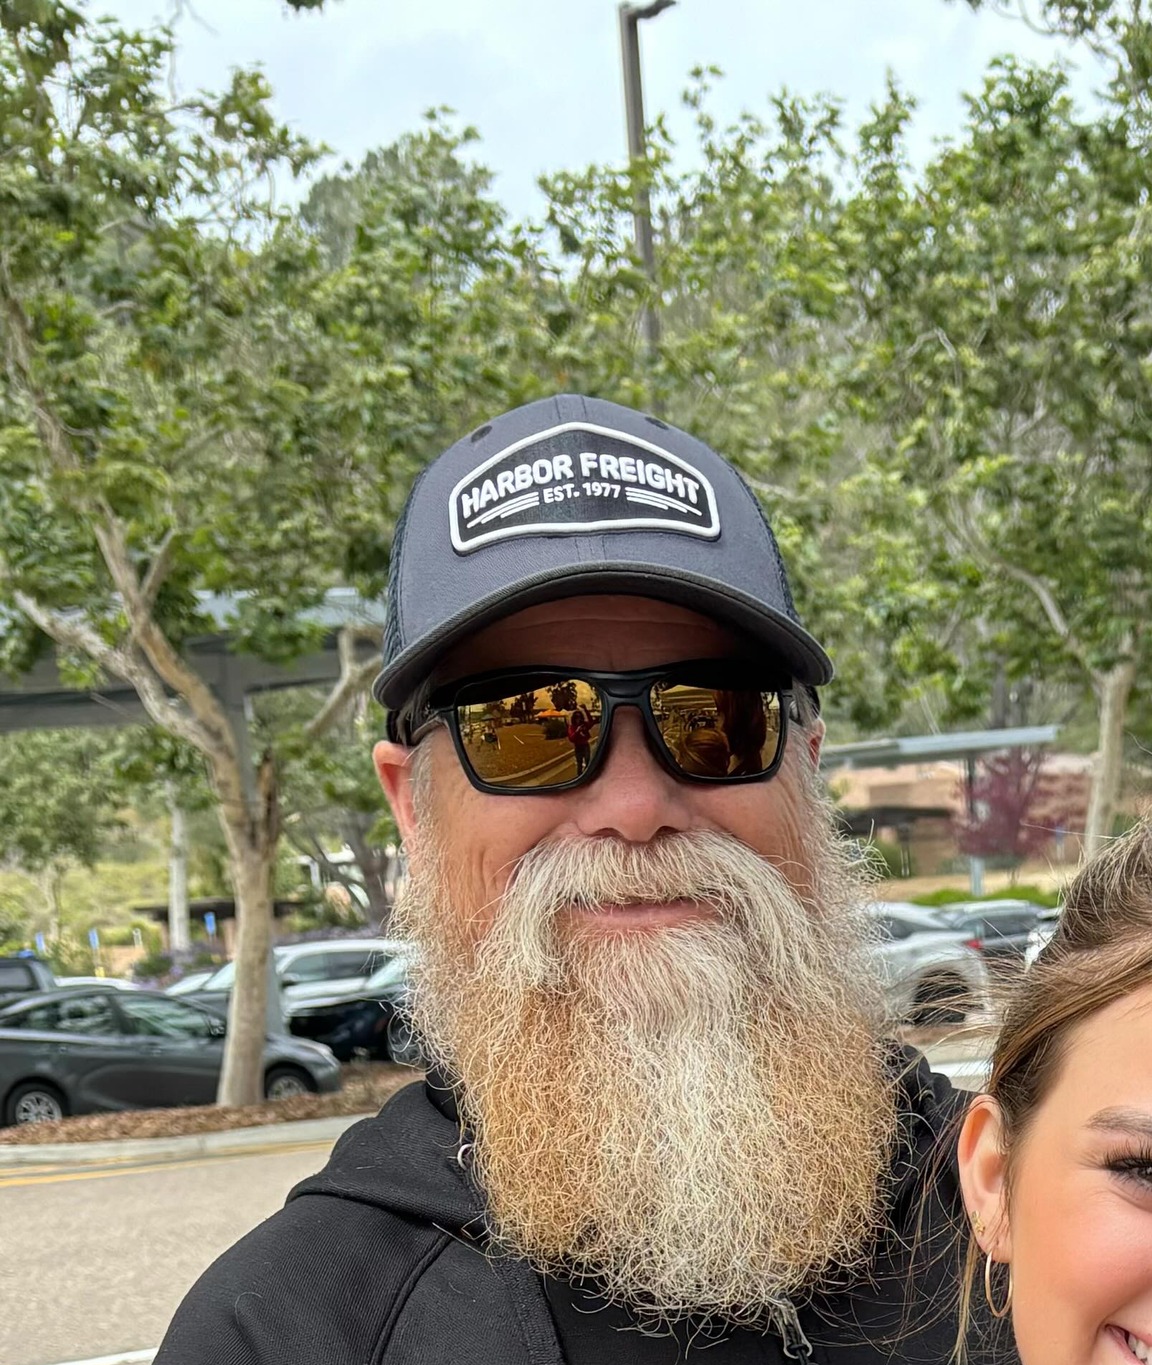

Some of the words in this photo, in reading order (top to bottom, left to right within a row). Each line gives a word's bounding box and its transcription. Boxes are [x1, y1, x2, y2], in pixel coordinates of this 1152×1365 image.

[461, 454, 574, 518] HARBOR
[579, 452, 700, 504] FREIGHT
[543, 483, 579, 503] EST.
[582, 482, 621, 498] 1977
